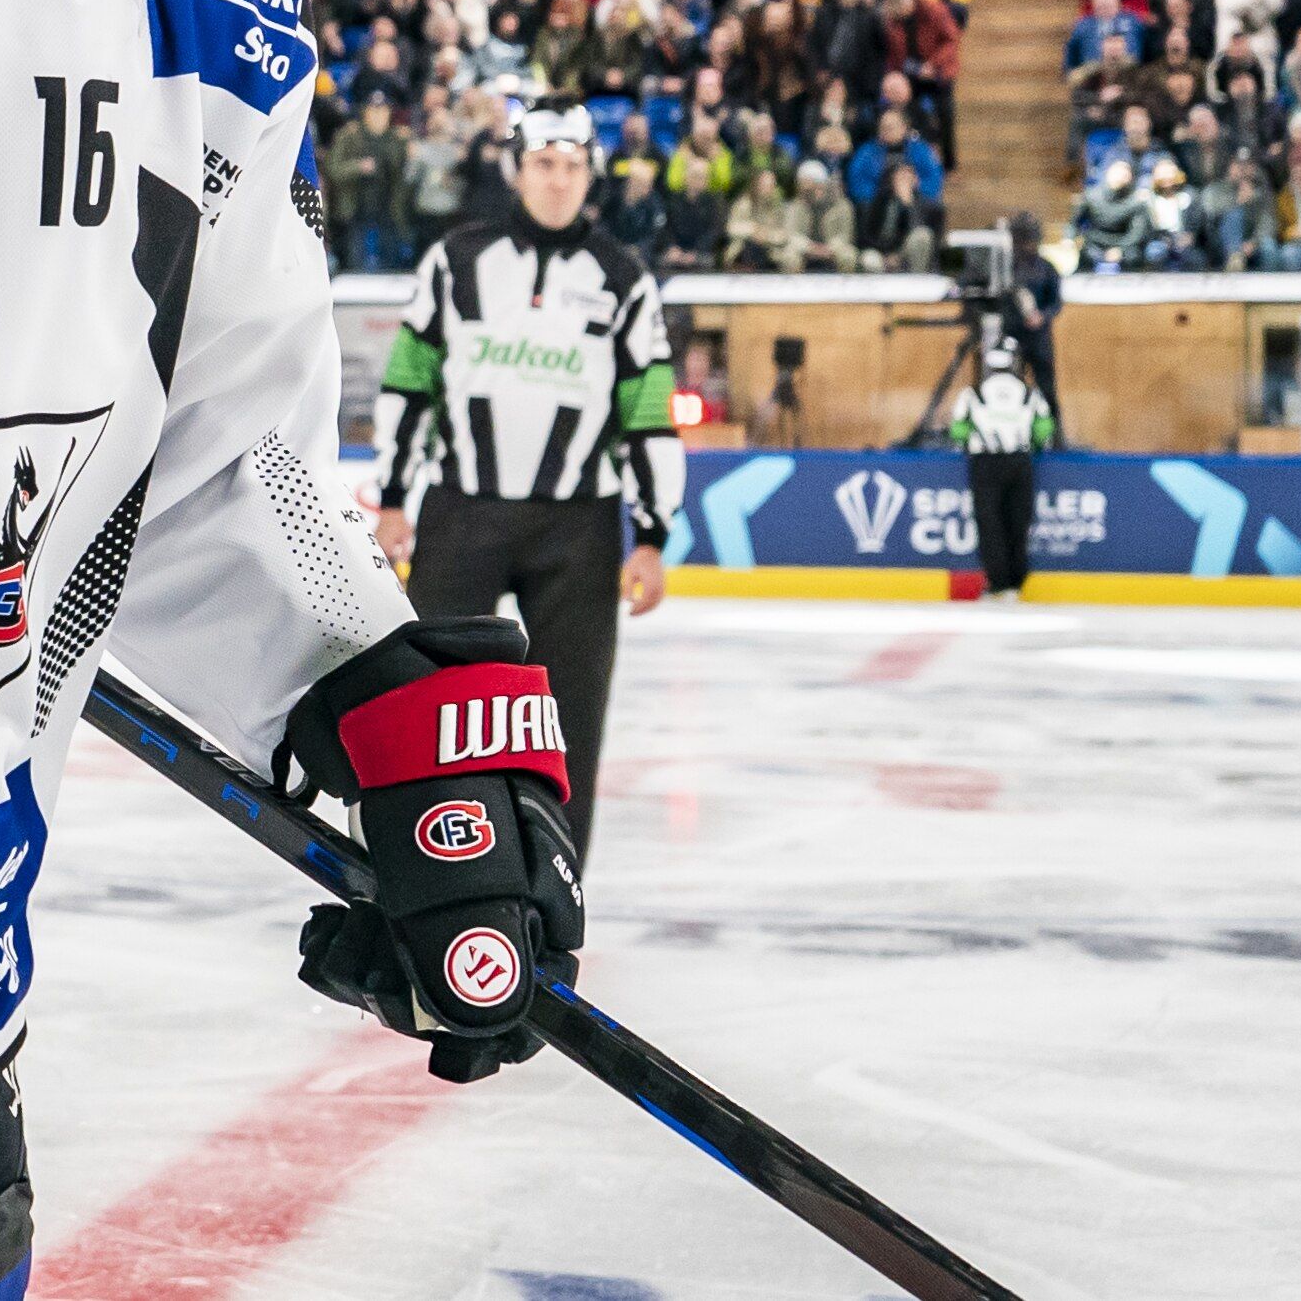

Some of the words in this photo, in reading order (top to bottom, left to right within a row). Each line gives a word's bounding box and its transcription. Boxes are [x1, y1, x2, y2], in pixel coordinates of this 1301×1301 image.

[234, 26, 291, 81] Sto
[36, 76, 119, 227] 16
[472, 336, 584, 375] Jakob
[910, 519, 981, 555] CU
